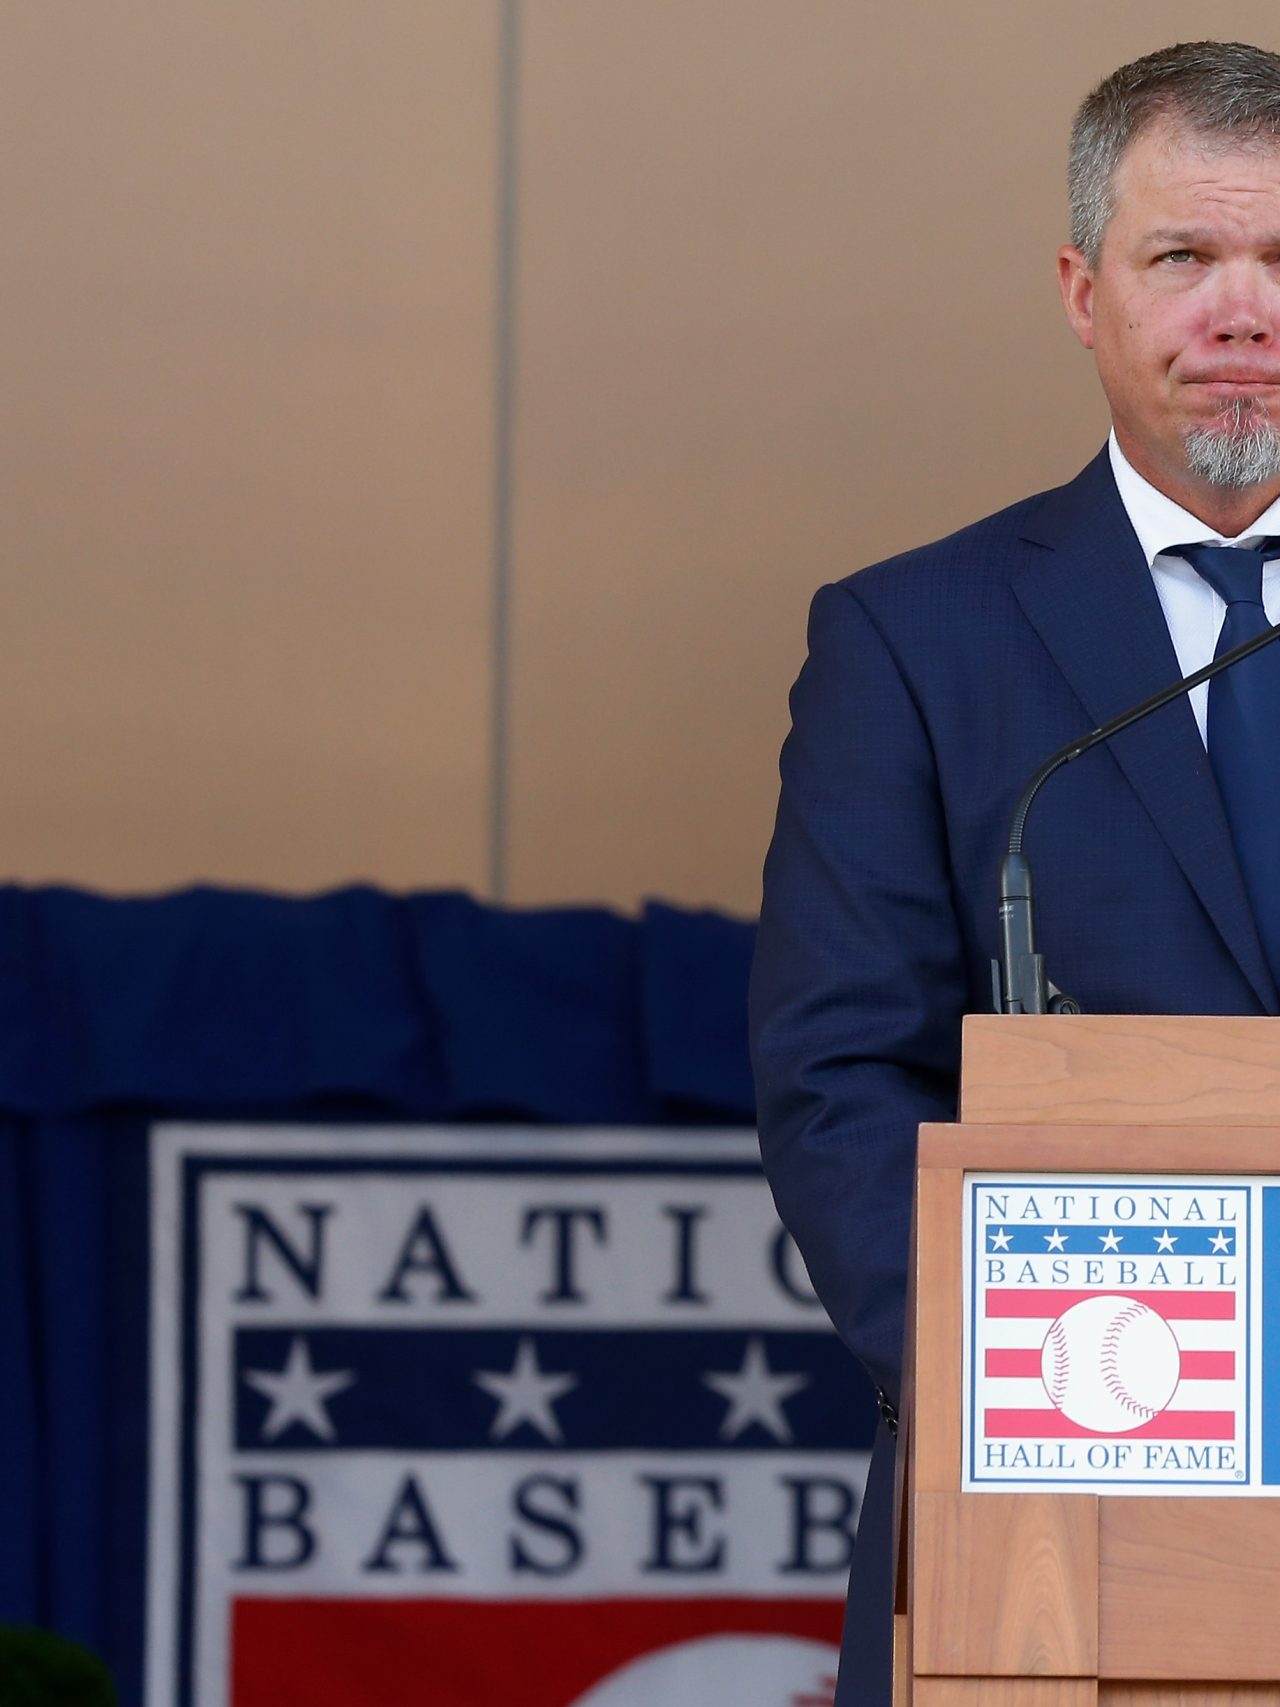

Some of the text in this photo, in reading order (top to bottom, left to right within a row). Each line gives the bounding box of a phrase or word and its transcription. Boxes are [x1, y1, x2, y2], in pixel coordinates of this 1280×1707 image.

[985, 1195, 1237, 1221] NATIONAL
[985, 1259, 1237, 1286] BASEBALL
[983, 1444, 1237, 1470] HALL OF FAME
